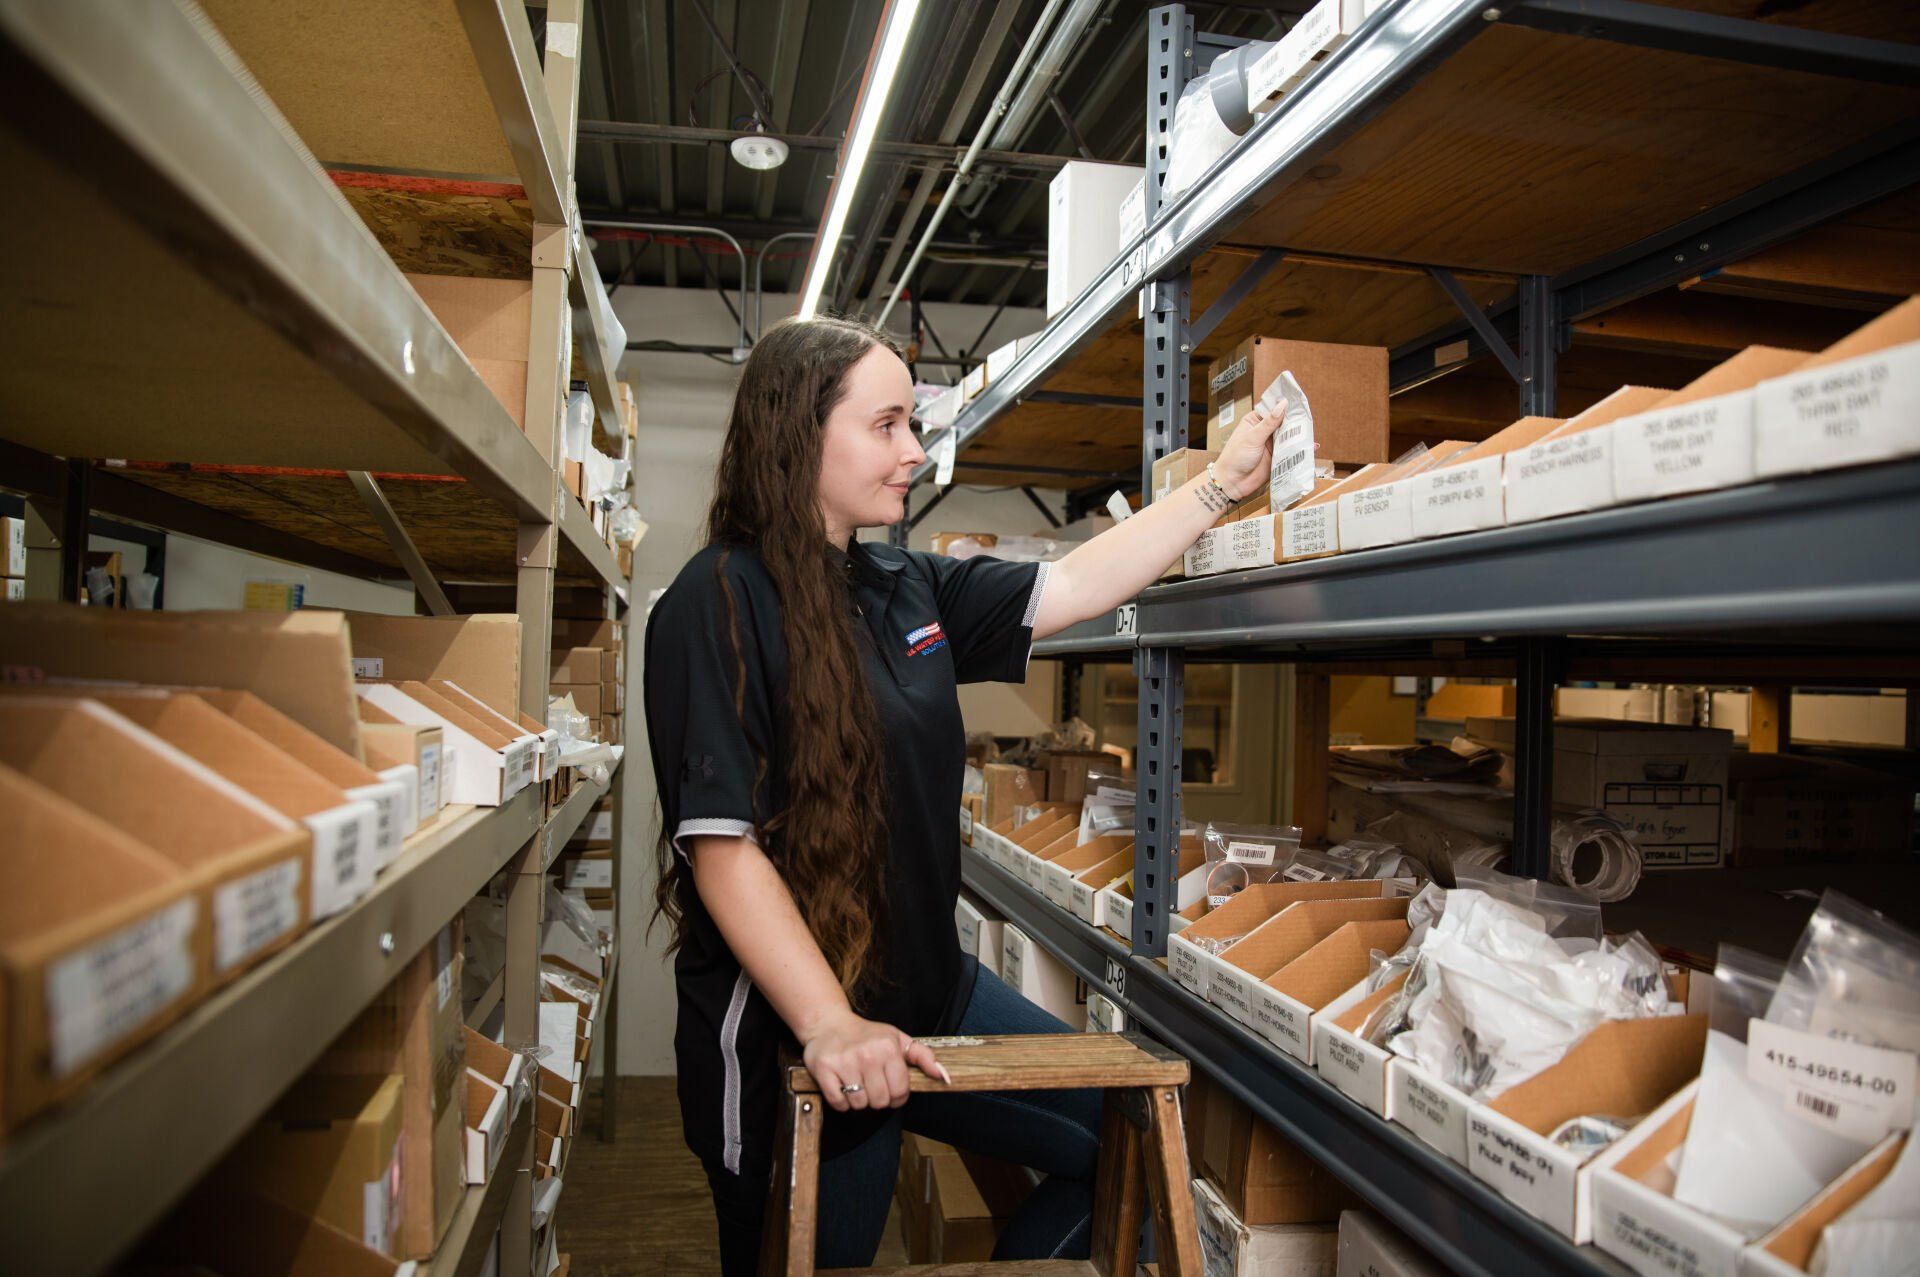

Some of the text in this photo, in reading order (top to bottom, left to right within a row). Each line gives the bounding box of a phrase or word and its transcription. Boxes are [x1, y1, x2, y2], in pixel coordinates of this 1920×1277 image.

[1520, 446, 1603, 478] SENSOR HARNESS
[1654, 455, 1703, 474] YELLOW
[1364, 499, 1389, 515] SENSOR
[1117, 606, 1136, 632] D-7
[1213, 896, 1226, 904] 233
[1106, 957, 1125, 994] D-8
[1258, 1010, 1300, 1043] PILOT-HONEYWELL
[1329, 1047, 1345, 1064] PILOT
[1766, 1049, 1897, 1095] 415-49654-00
[1408, 1092, 1427, 1111] PILOT
